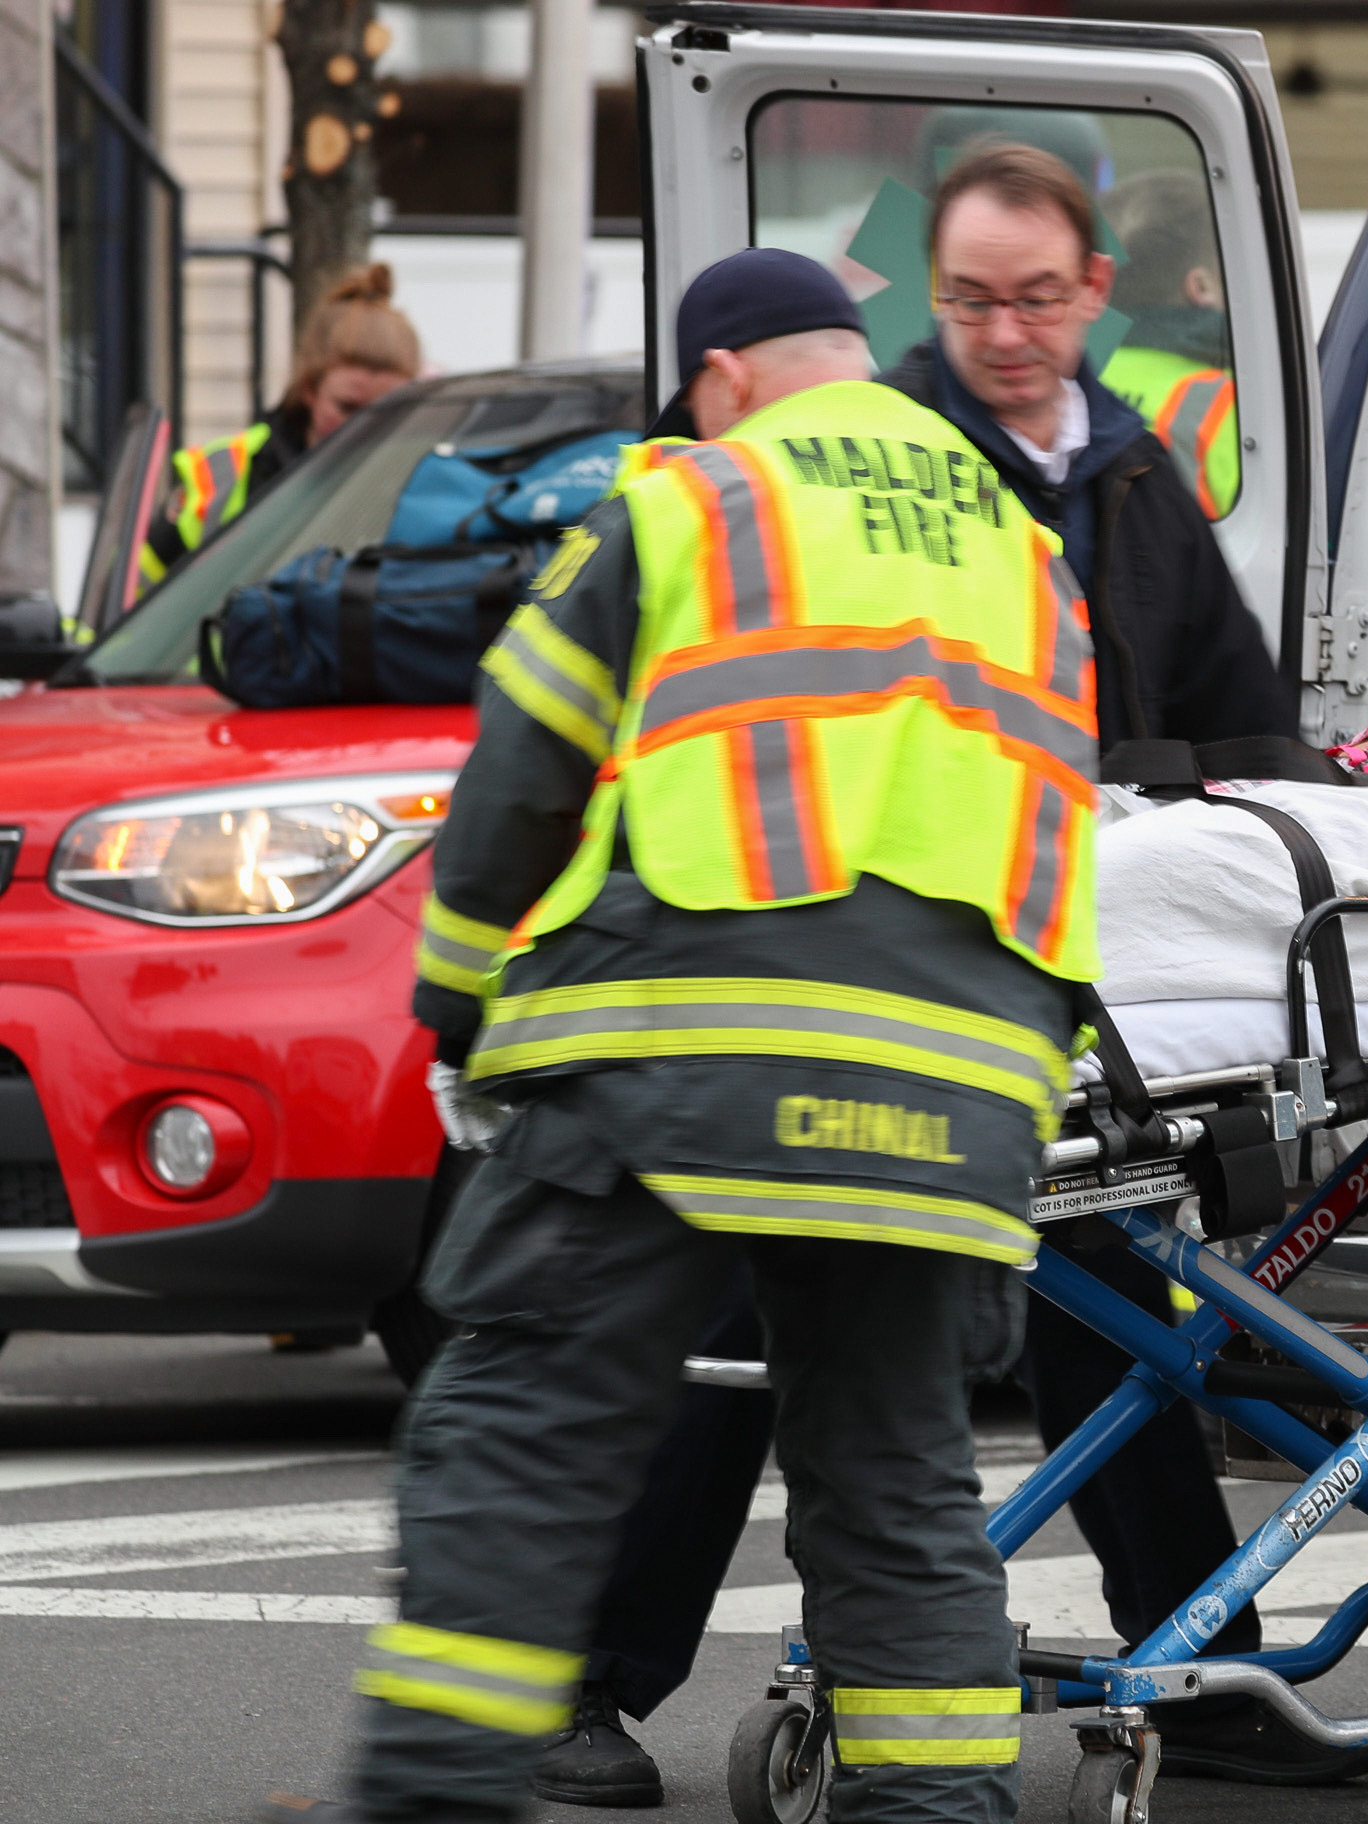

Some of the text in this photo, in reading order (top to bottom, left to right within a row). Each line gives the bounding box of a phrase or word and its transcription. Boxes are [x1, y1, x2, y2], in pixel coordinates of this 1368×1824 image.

[1034, 1202, 1052, 1214] COT
[1053, 1200, 1062, 1211] IS
[1063, 1196, 1082, 1209] FOR
[1083, 1188, 1151, 1204] PROFESSIONAL
[1151, 1183, 1169, 1195] USE
[1059, 1181, 1070, 1191] DO
[1071, 1178, 1085, 1188] NOT
[1133, 1169, 1153, 1178] HAND
[1154, 1163, 1178, 1174] GUARD
[1254, 1208, 1337, 1290] TALDO
[1278, 1457, 1362, 1542] FERNO
